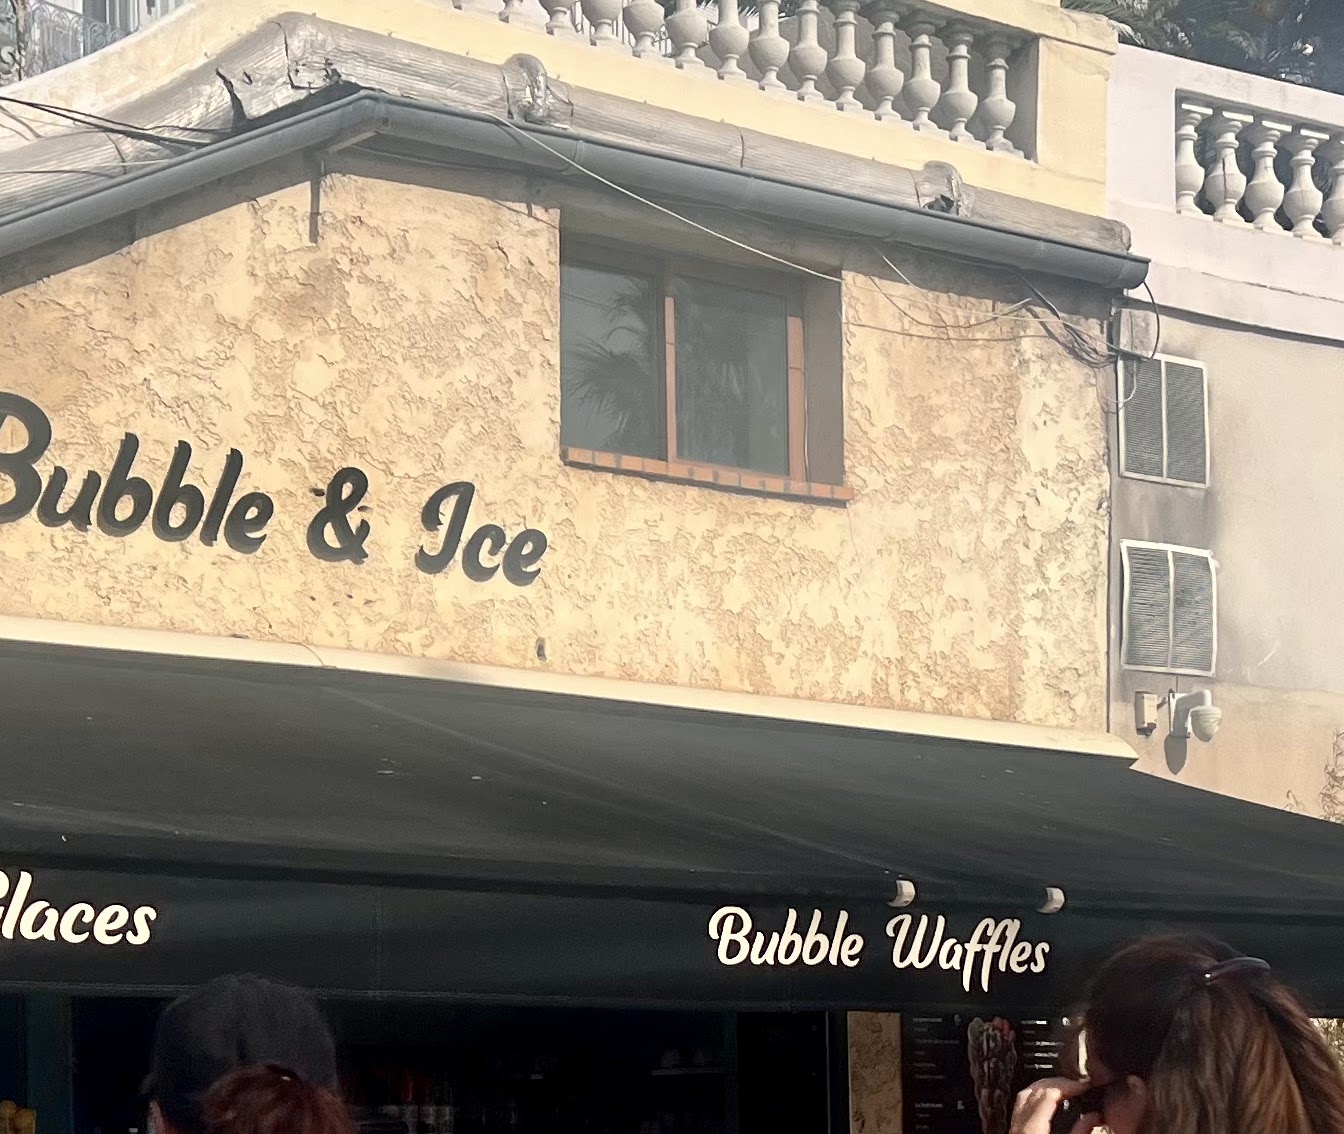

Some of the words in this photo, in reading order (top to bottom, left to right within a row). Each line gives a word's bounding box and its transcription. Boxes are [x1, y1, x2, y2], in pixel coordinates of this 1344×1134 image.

[307, 467, 369, 565] &
[415, 481, 549, 587] Ice
[708, 905, 865, 968] Bubble
[885, 913, 1051, 993] Waffles
